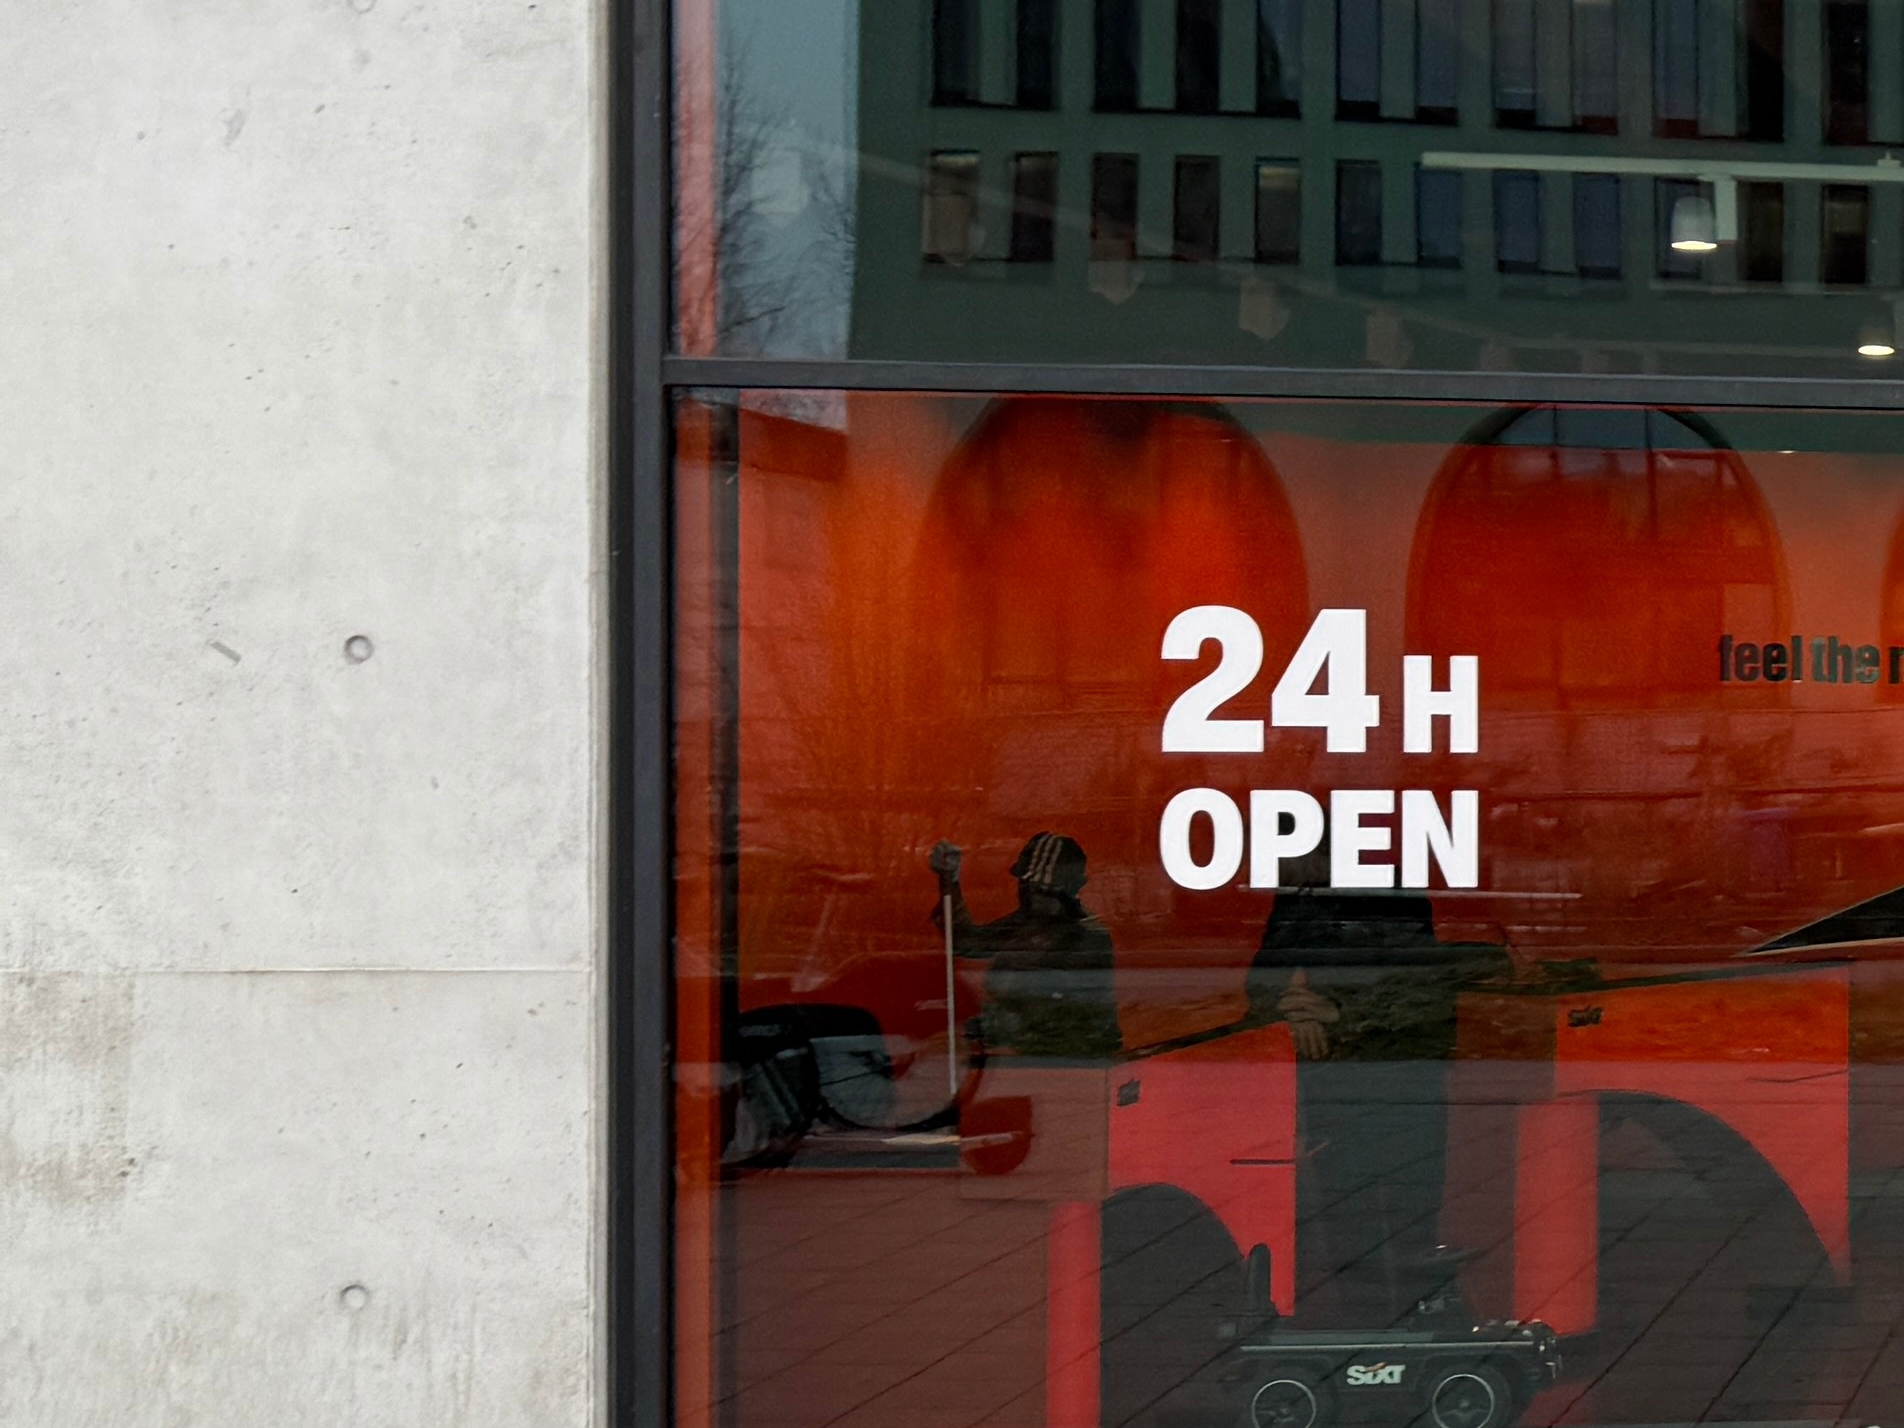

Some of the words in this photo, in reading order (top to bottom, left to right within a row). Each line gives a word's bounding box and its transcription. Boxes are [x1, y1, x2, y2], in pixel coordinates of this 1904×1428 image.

[1718, 634, 1803, 683] feel
[1811, 635, 1881, 684] the
[1160, 788, 1478, 889] OPEN
